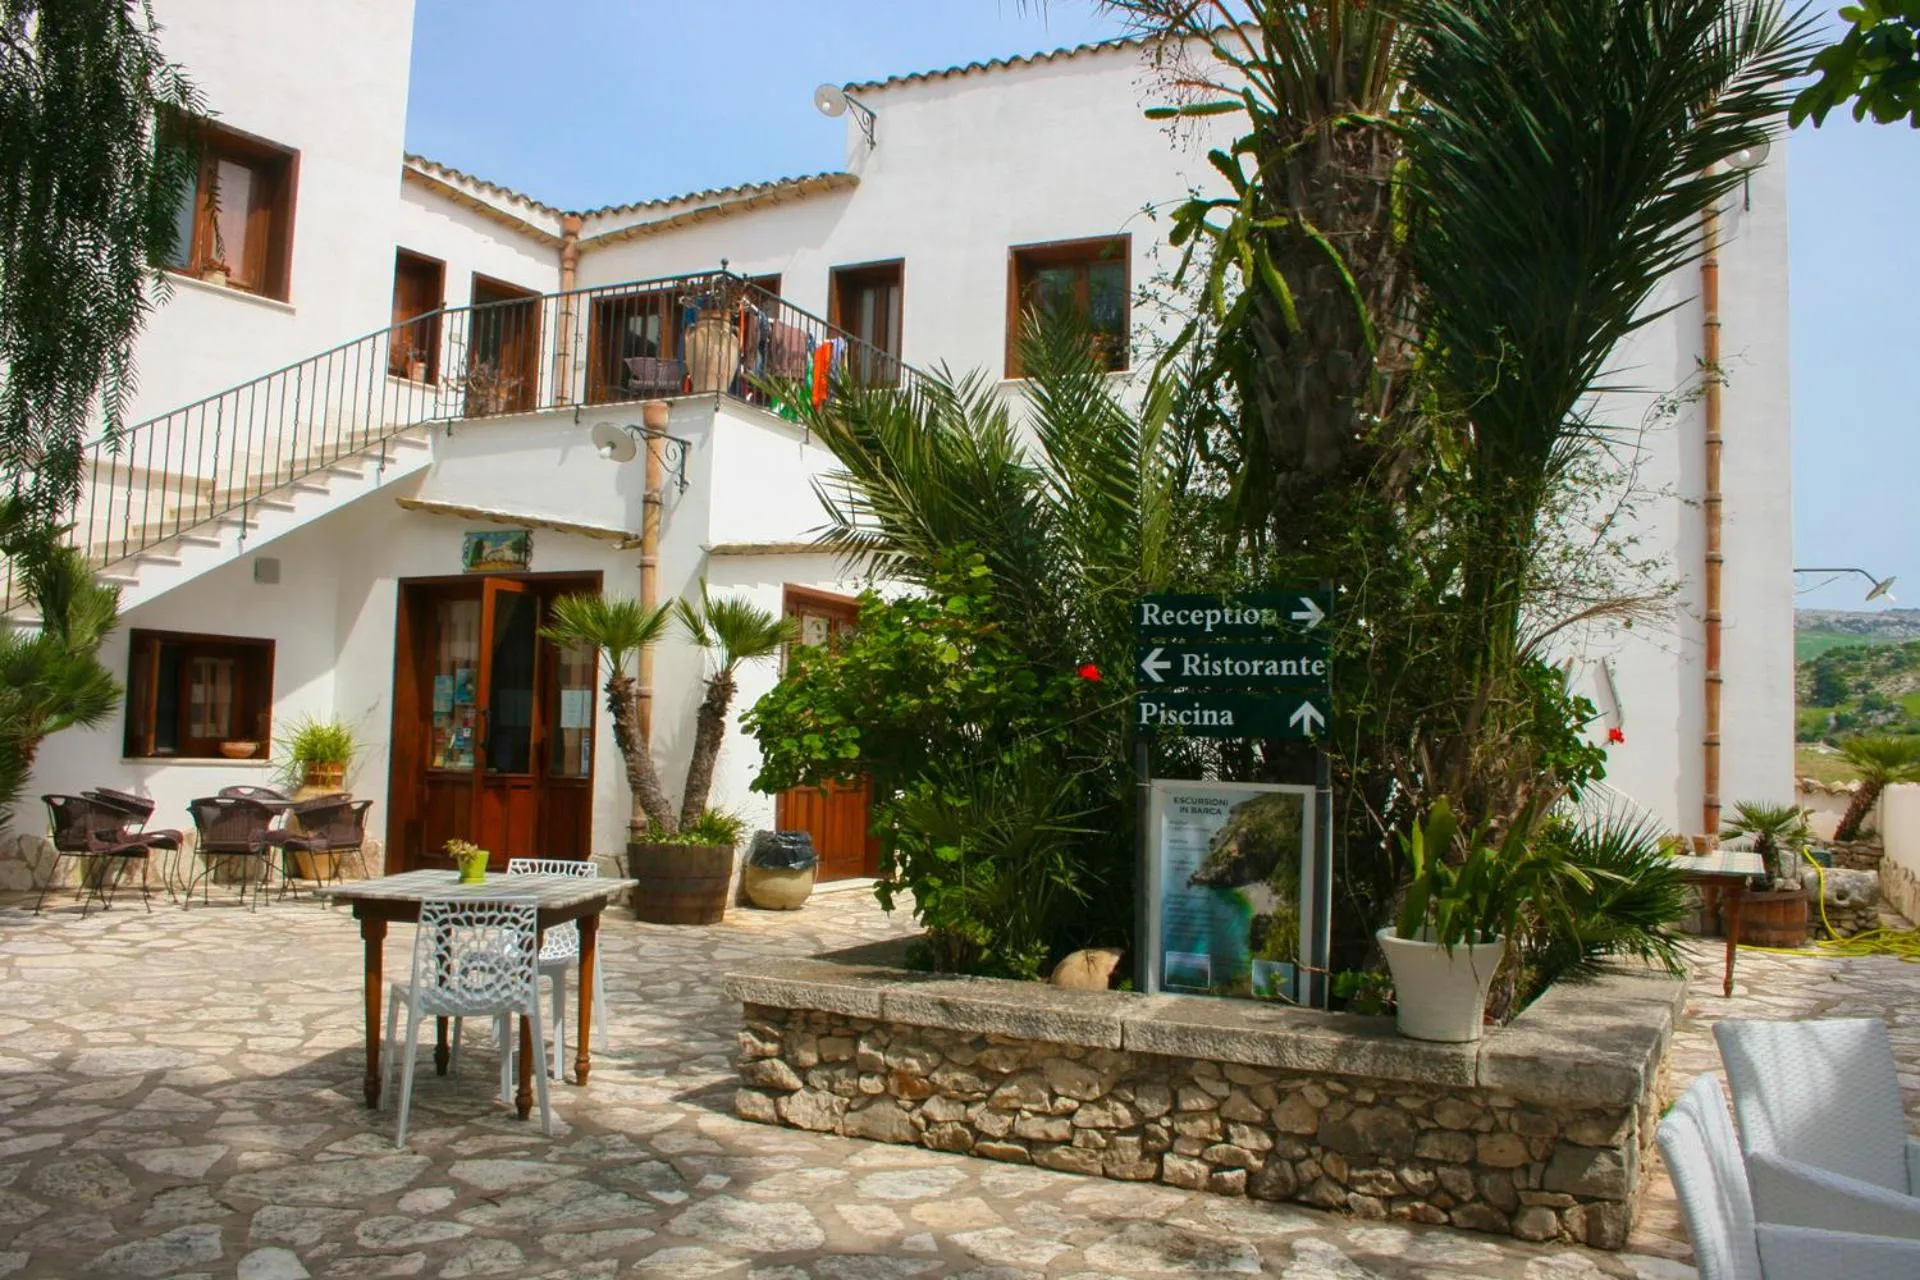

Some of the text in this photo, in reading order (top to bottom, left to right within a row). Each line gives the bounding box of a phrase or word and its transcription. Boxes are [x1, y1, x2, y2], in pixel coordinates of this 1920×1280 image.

[1181, 653, 1326, 676] Ristorante
[1139, 702, 1235, 726] Piscina
[1173, 796, 1229, 807] ESCURSIONI
[1179, 806, 1223, 816] IN BARCA
